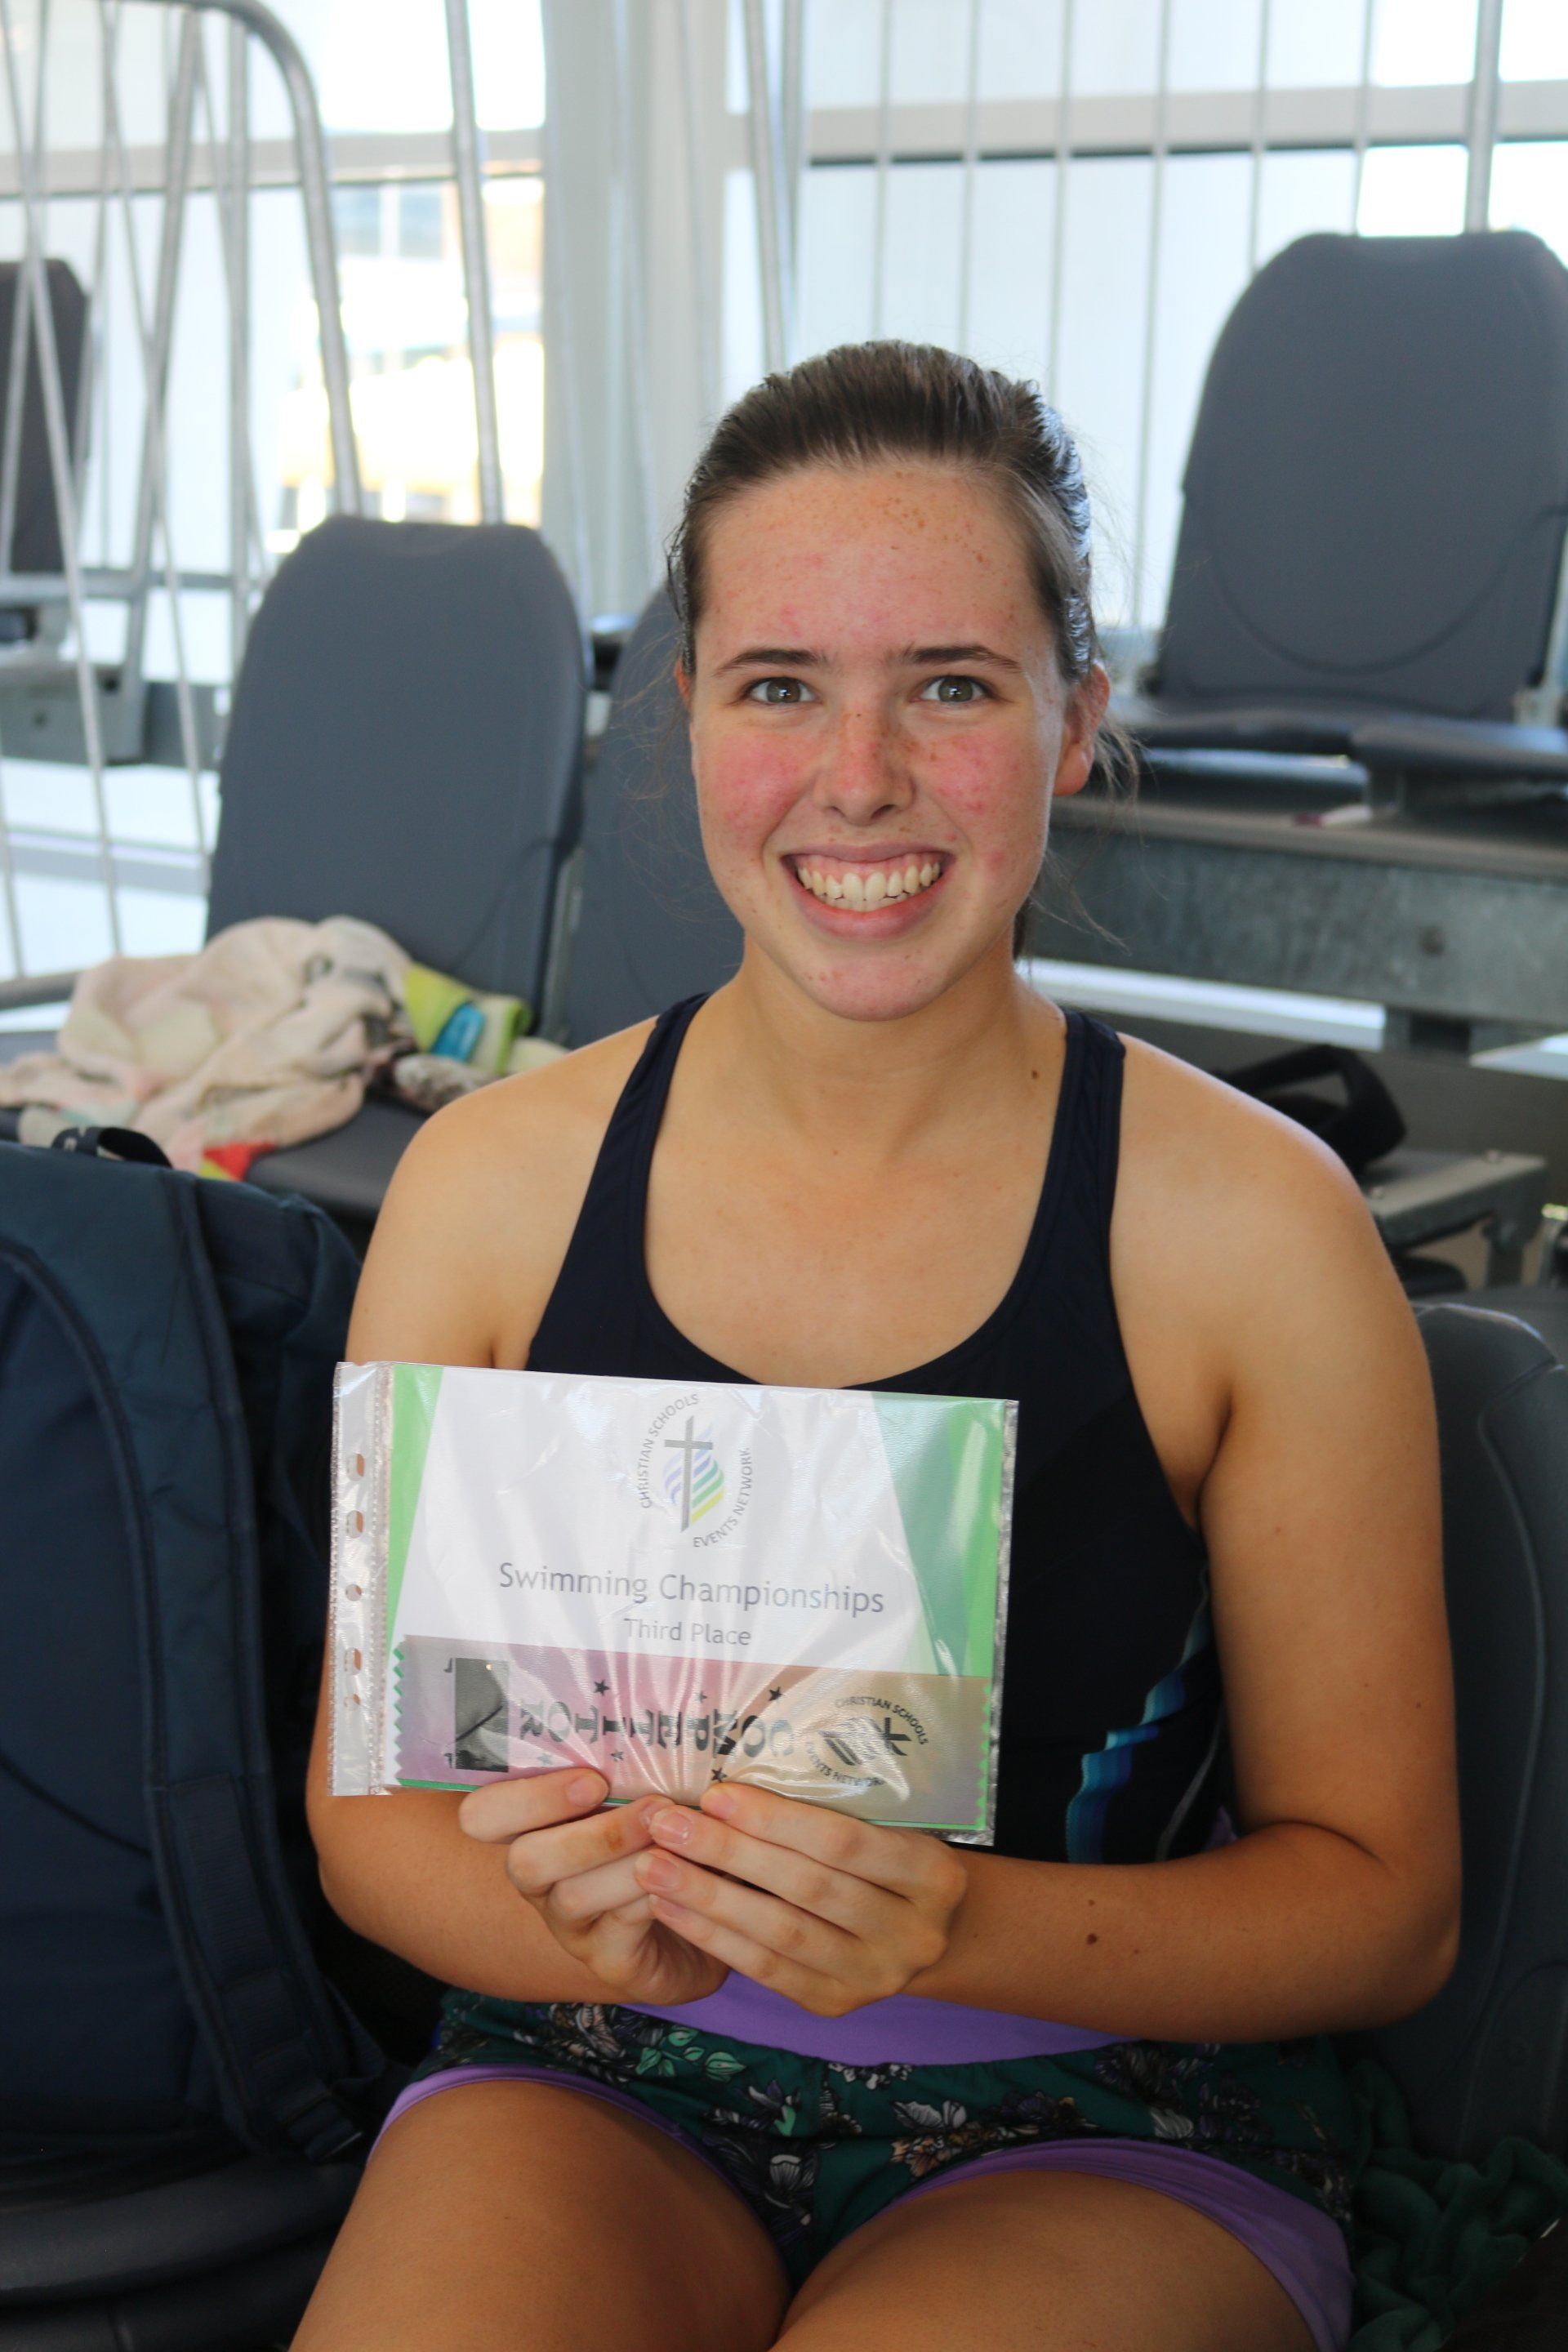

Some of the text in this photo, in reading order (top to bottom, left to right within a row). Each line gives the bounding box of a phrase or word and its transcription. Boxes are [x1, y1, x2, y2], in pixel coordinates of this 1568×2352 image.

[637, 1394, 699, 1508] CHRISTIAN SCHOOLS
[693, 1448, 753, 1548] EVENTS NETWORK
[499, 1561, 884, 1619] Swimming Championships
[623, 1618, 751, 1646] Third Place
[891, 1704, 929, 1745] SCHOOLS
